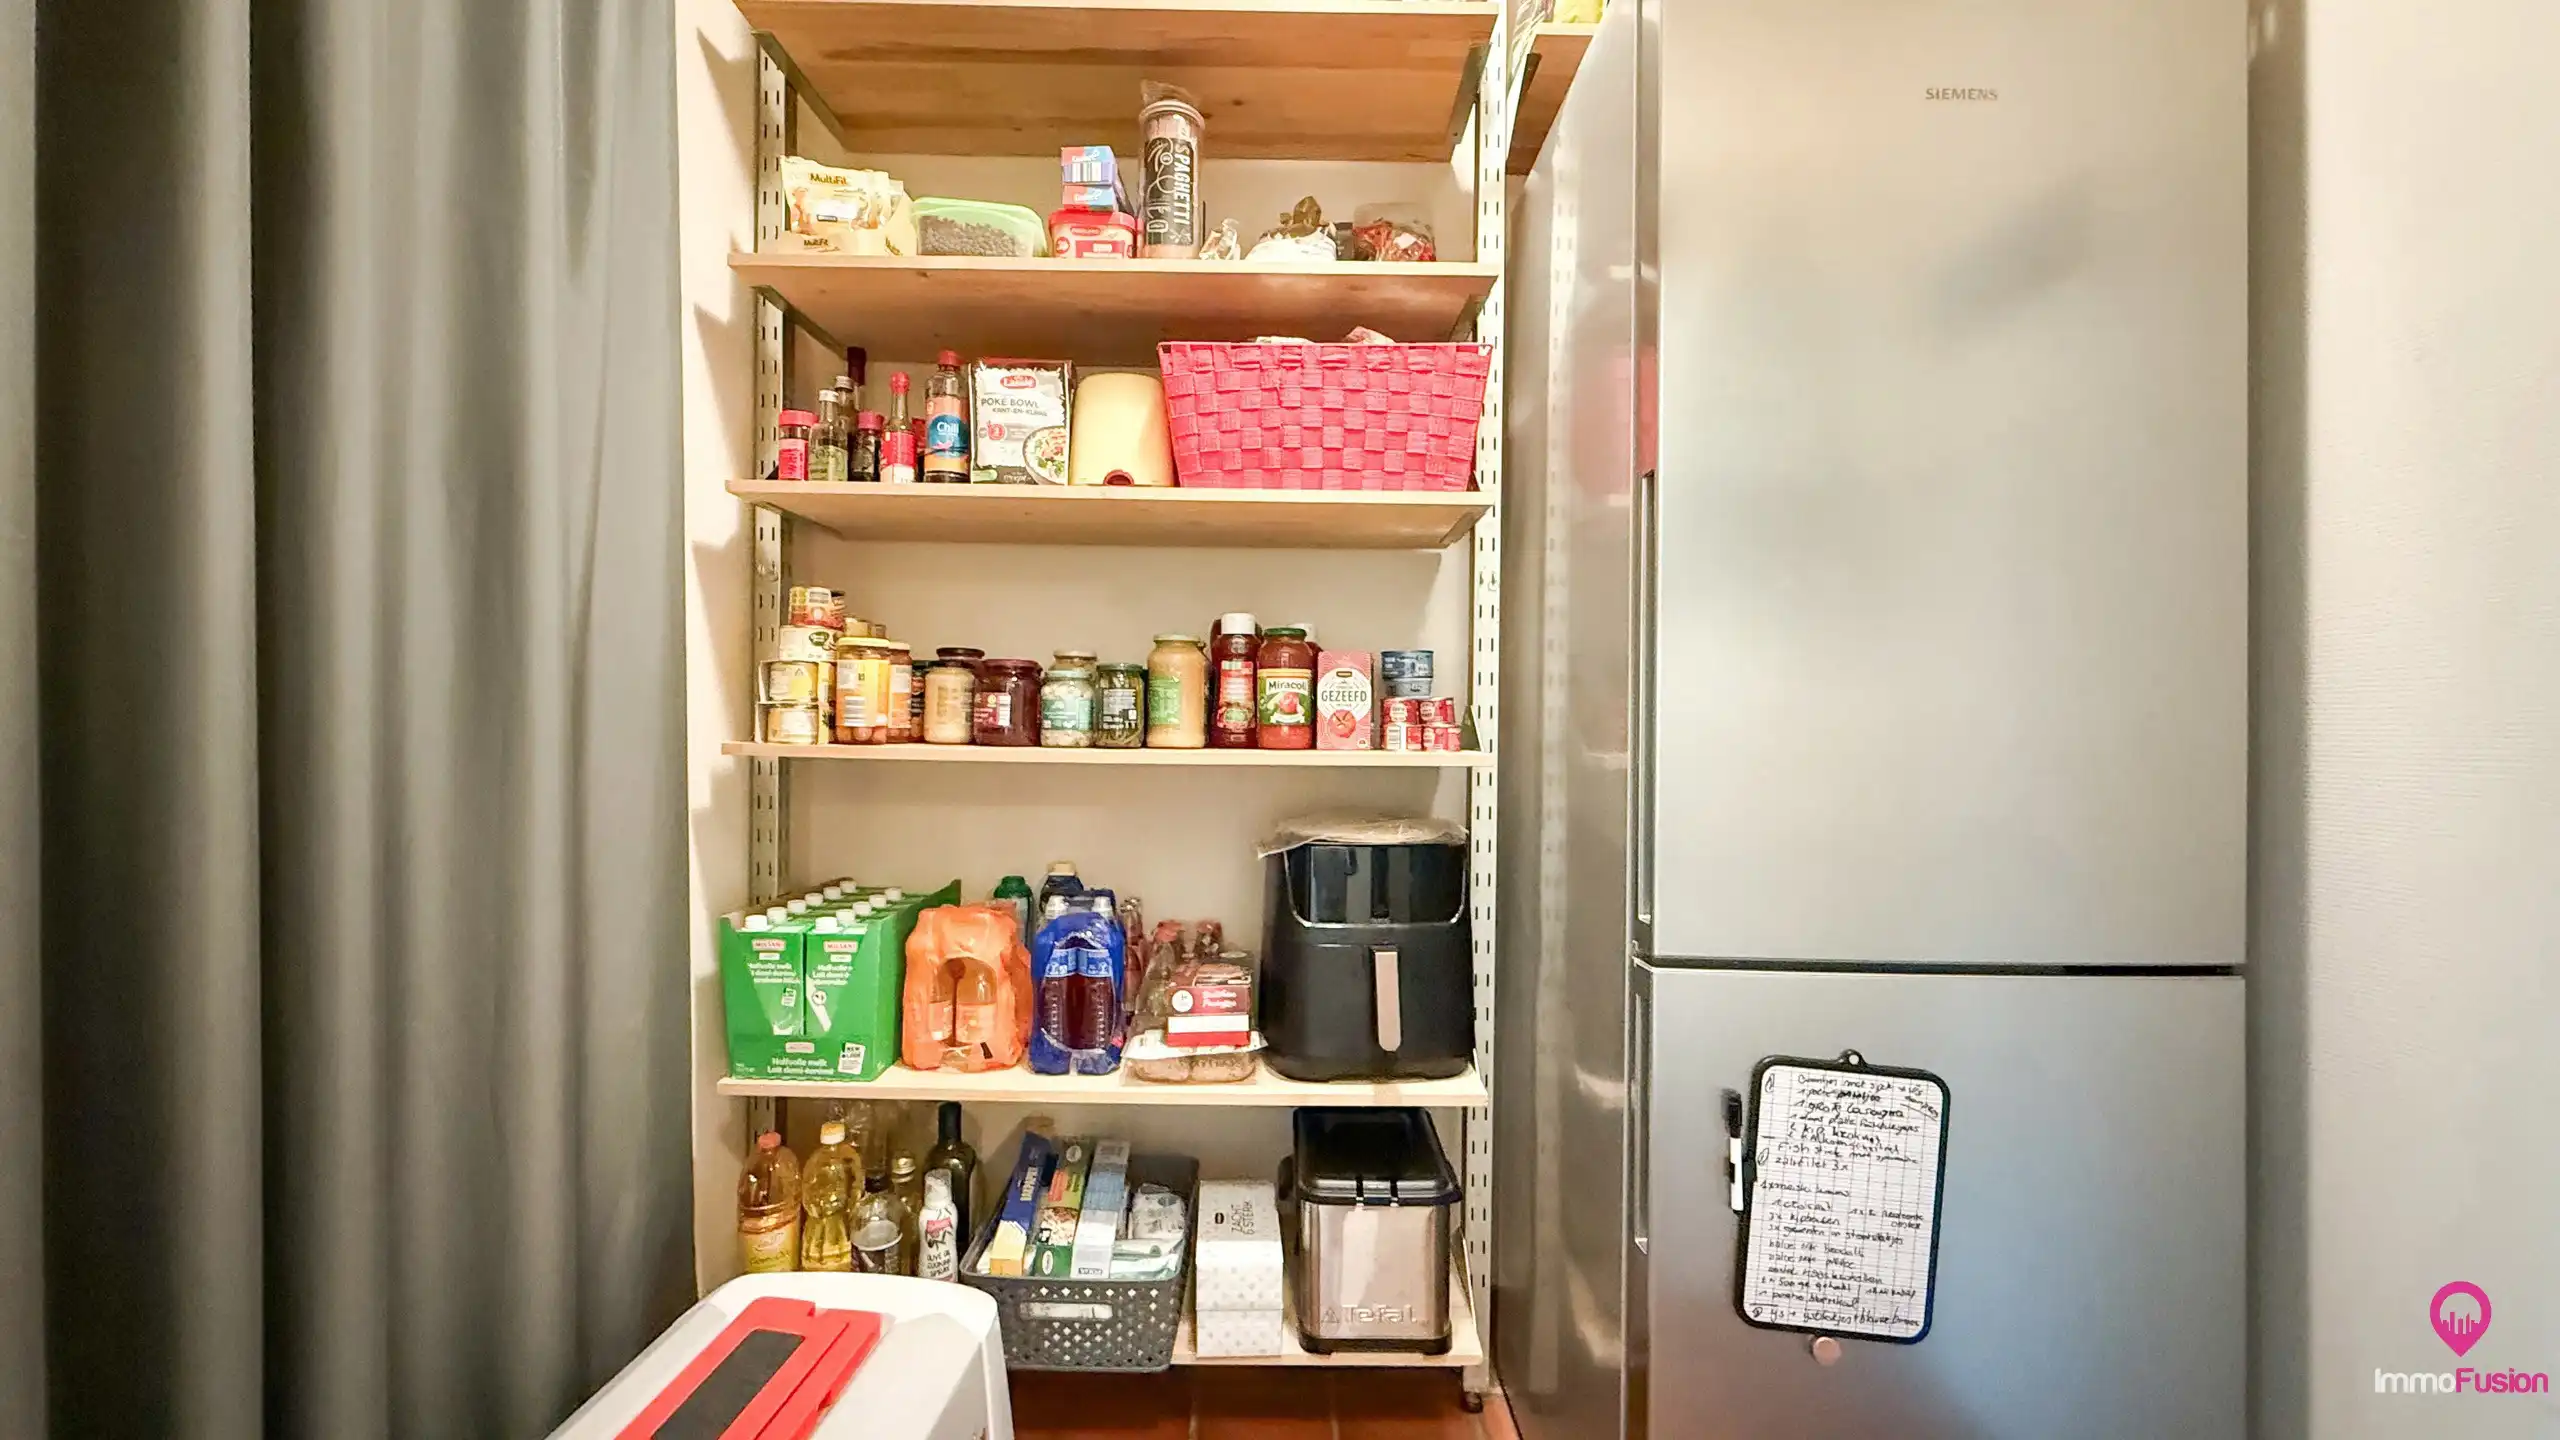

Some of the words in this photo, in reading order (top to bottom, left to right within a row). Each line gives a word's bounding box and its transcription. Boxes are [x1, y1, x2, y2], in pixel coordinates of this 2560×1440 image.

[1925, 87, 1999, 101] SIEMENS
[809, 172, 847, 186] MultiFit
[1173, 144, 1191, 225] SPAGHETTI
[1010, 398, 1039, 408] BOWL
[1321, 690, 1367, 702] GEZEEFD
[1341, 1303, 1418, 1324] Tefal
